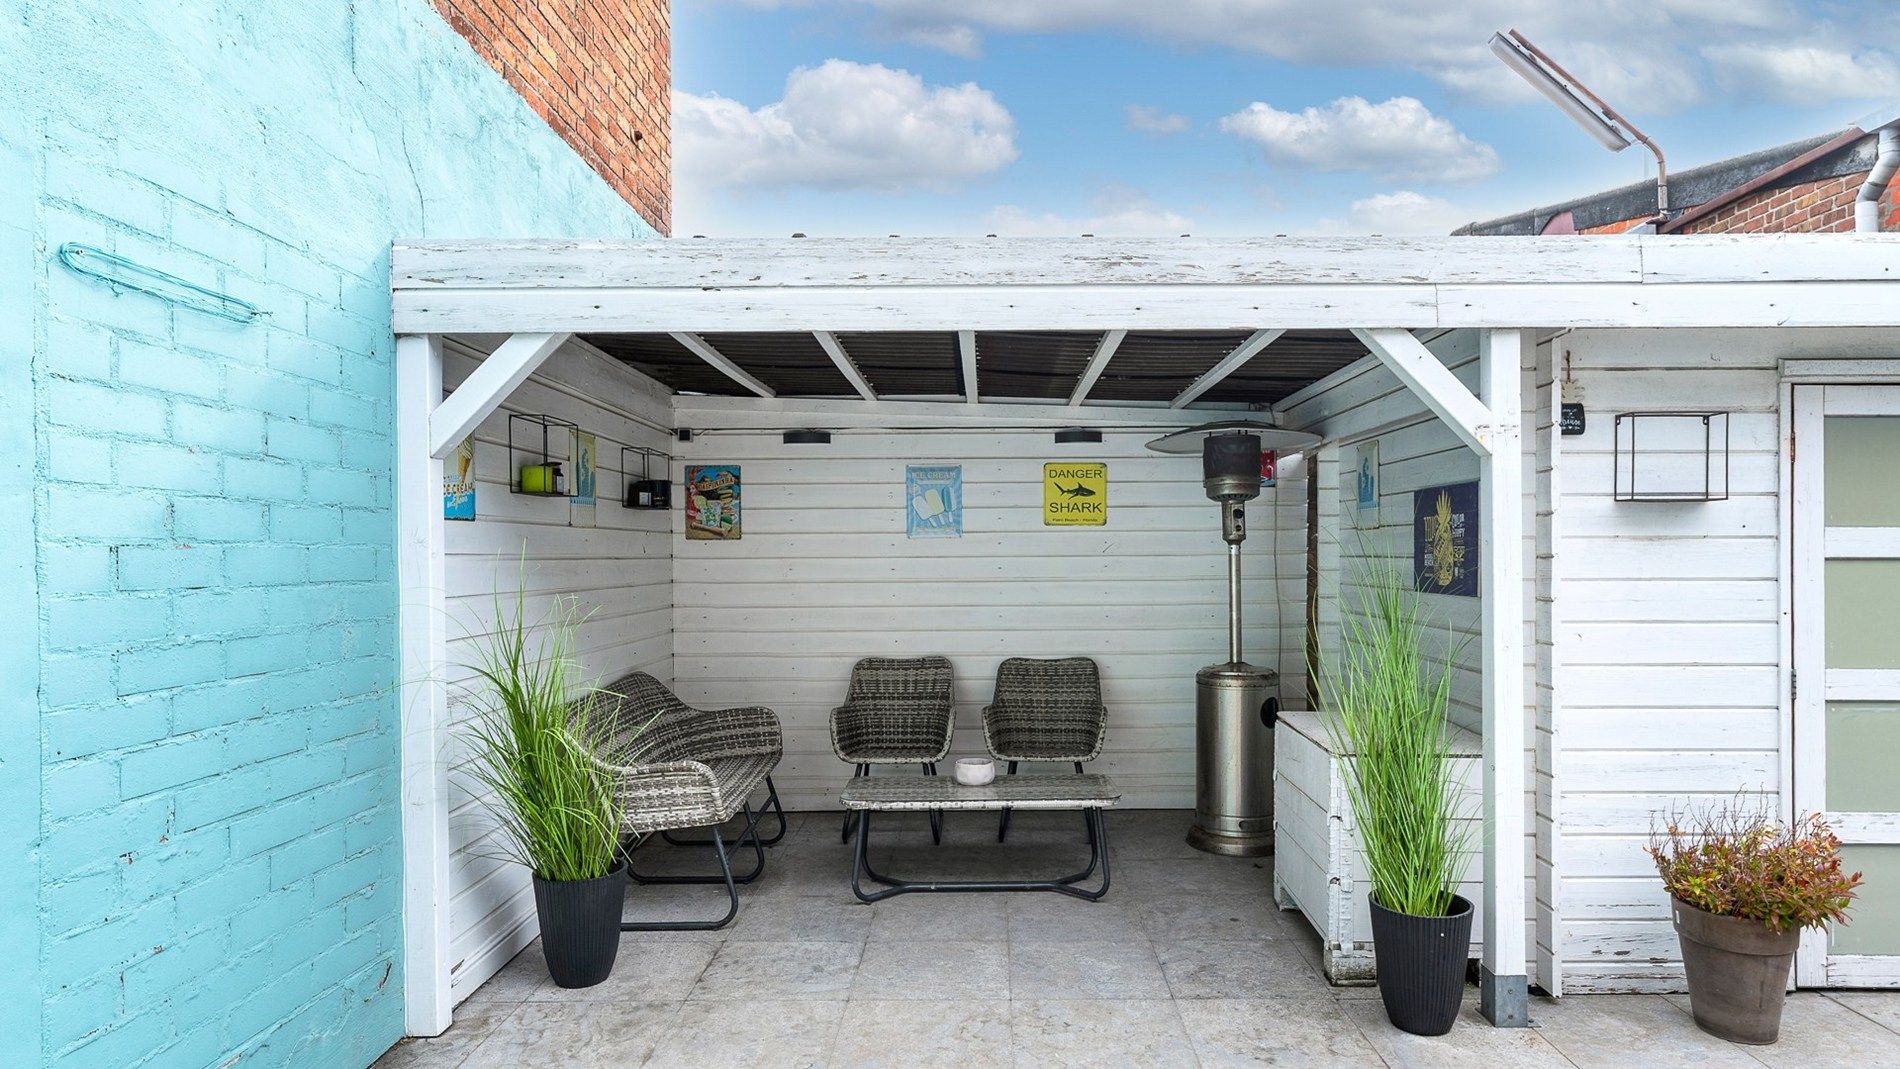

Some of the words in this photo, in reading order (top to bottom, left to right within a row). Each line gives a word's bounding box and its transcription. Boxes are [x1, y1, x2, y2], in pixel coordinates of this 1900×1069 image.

[926, 471, 957, 480] CREAM
[1049, 469, 1103, 479] DANGER
[453, 481, 475, 495] CREAM
[1049, 502, 1103, 514] SHARK
